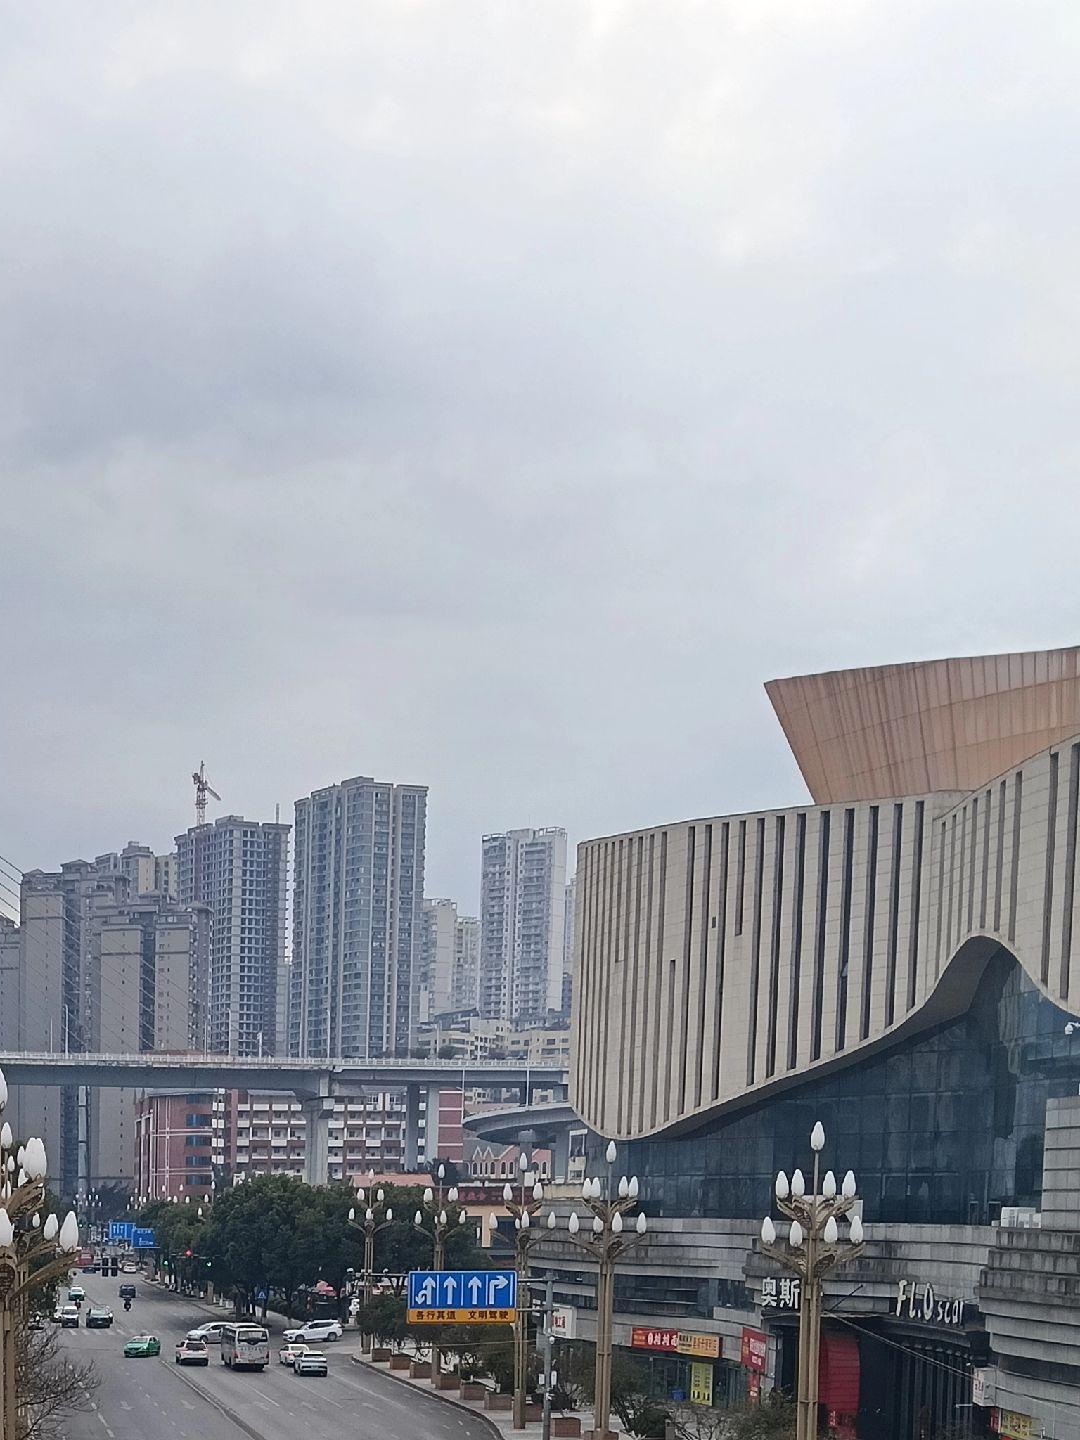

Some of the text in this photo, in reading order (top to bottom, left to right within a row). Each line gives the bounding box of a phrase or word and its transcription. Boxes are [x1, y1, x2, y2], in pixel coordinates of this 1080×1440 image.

[761, 1277, 801, 1310] 奥斯
[416, 1310, 509, 1320] 各行其道 文明驾驶
